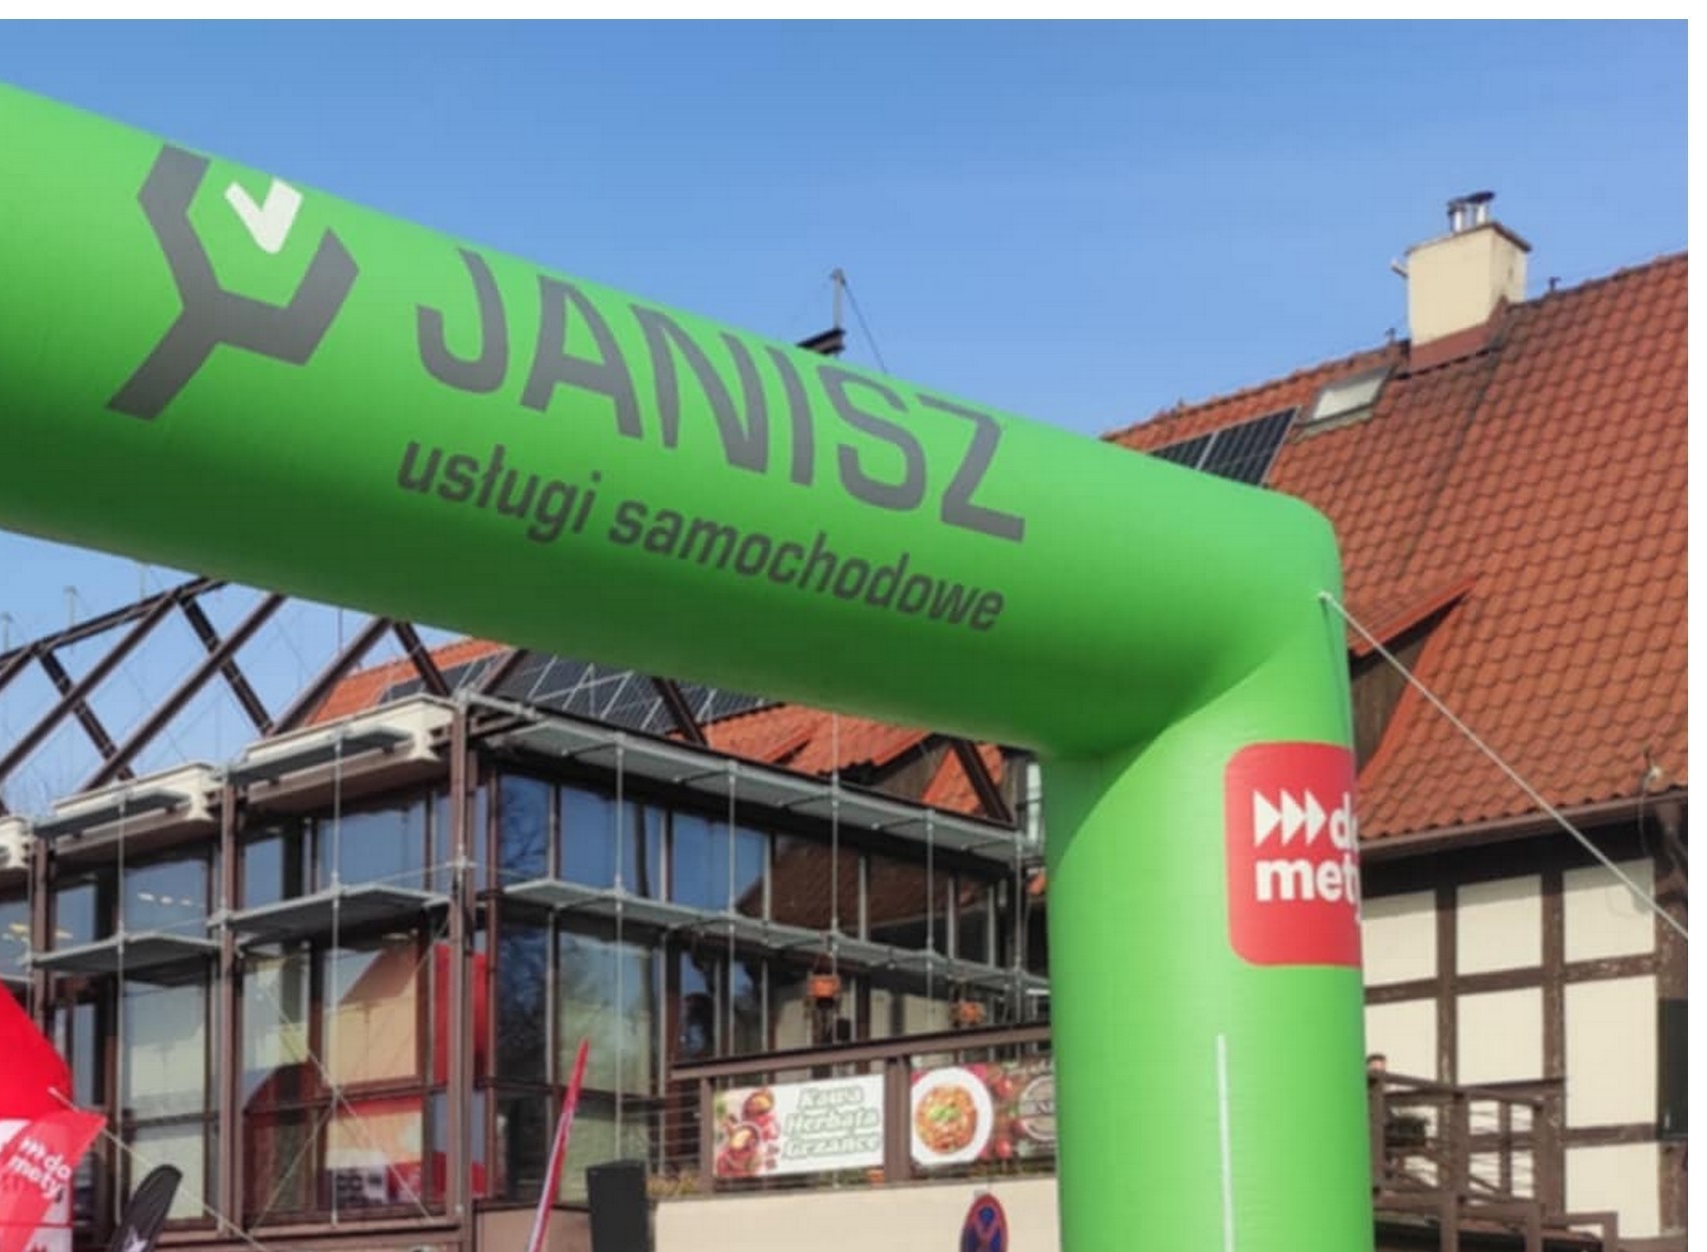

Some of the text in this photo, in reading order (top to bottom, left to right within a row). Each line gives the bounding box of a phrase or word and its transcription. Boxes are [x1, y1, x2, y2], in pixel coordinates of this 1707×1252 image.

[416, 247, 1025, 542] JANISZ
[397, 440, 1004, 632] usługi samochodowe
[1329, 792, 1359, 852] d
[1254, 852, 1363, 925] met
